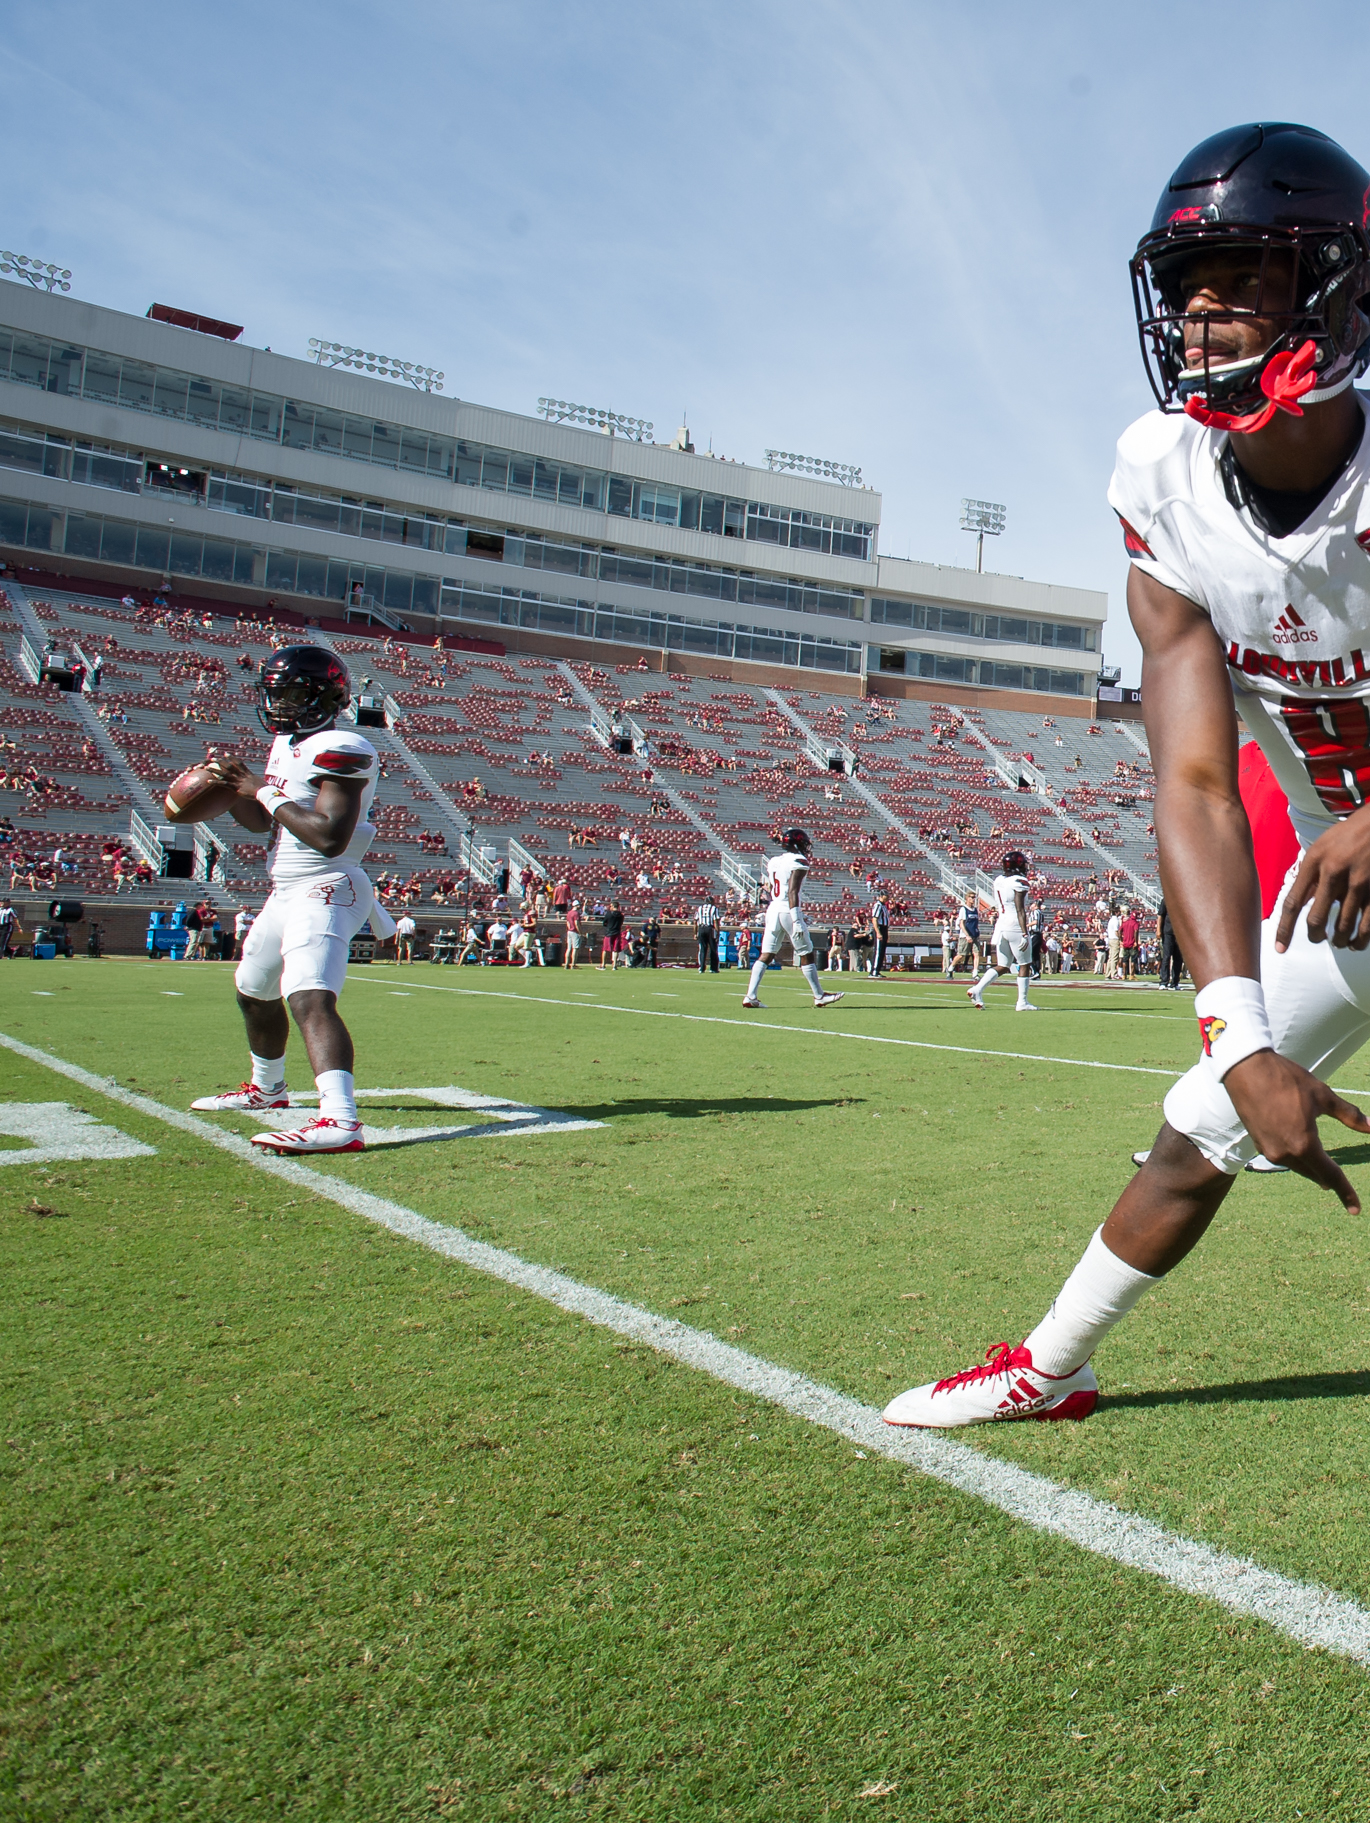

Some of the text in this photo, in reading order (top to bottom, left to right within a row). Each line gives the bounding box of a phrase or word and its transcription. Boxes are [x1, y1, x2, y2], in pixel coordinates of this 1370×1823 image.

[1167, 206, 1203, 223] ACC
[1272, 629, 1318, 644] adidas
[994, 1394, 1055, 1419] adidas
